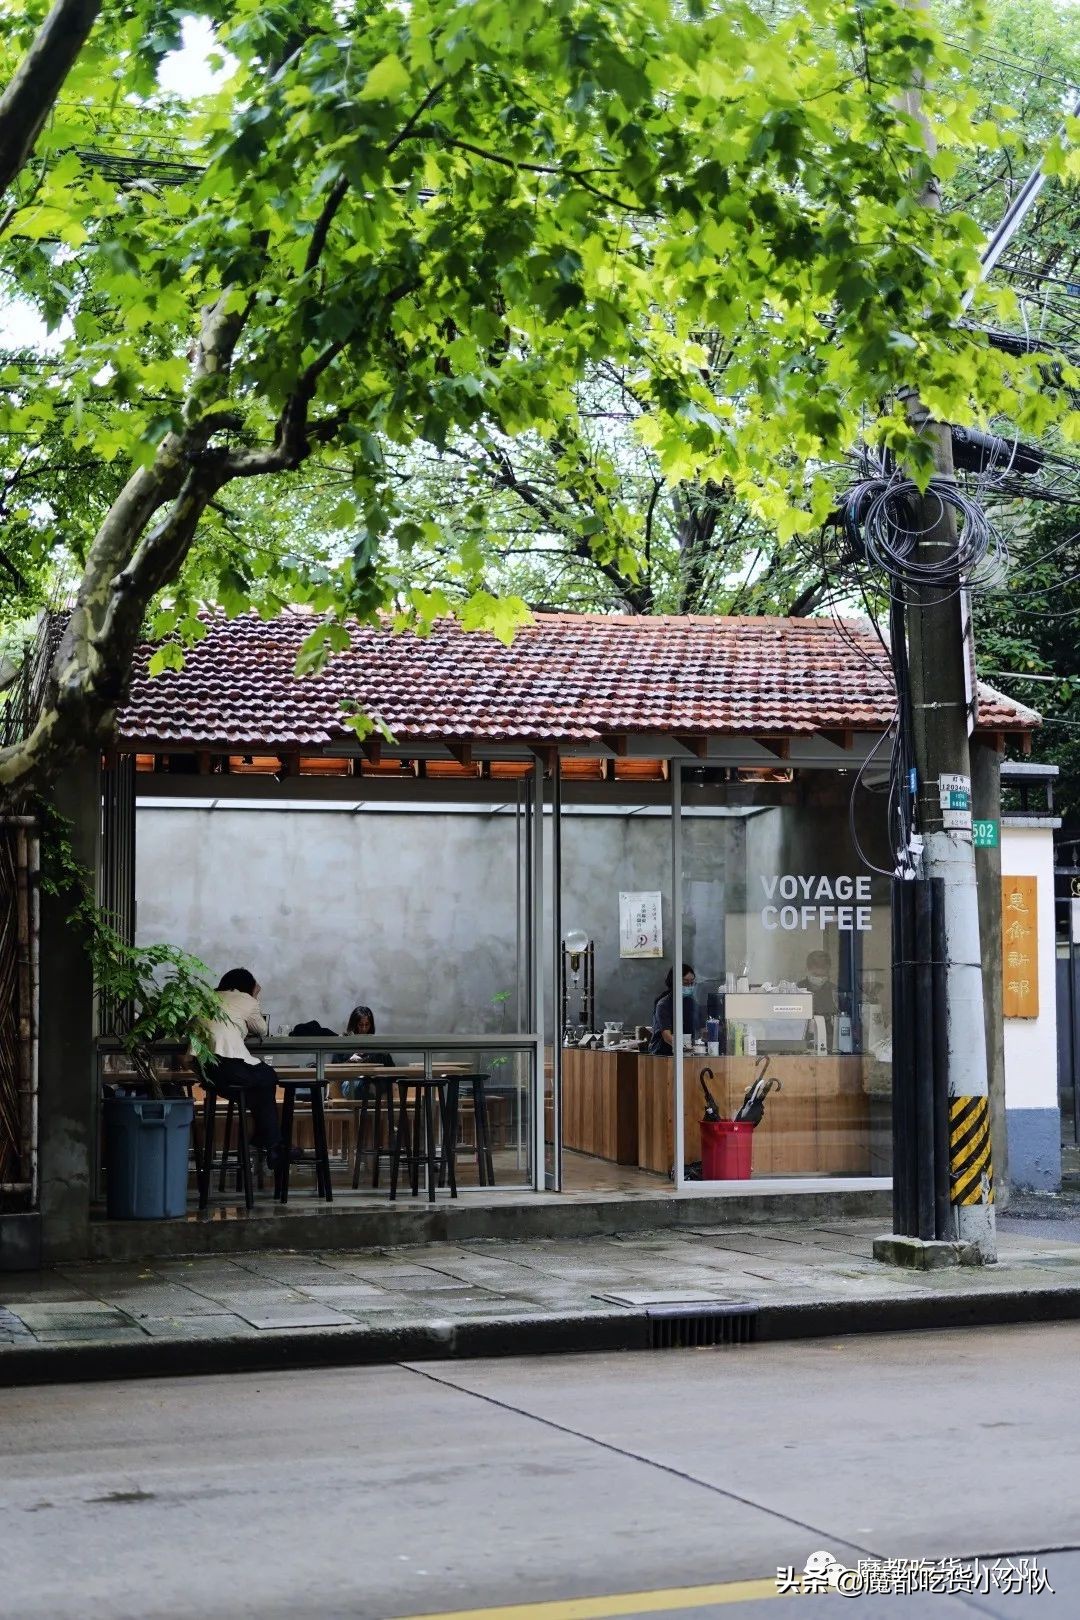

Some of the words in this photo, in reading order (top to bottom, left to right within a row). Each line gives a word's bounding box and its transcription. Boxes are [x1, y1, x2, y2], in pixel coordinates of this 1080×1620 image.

[972, 823, 994, 838] 502
[760, 875, 872, 900] VOYAGE
[761, 905, 873, 931] COFFEE
